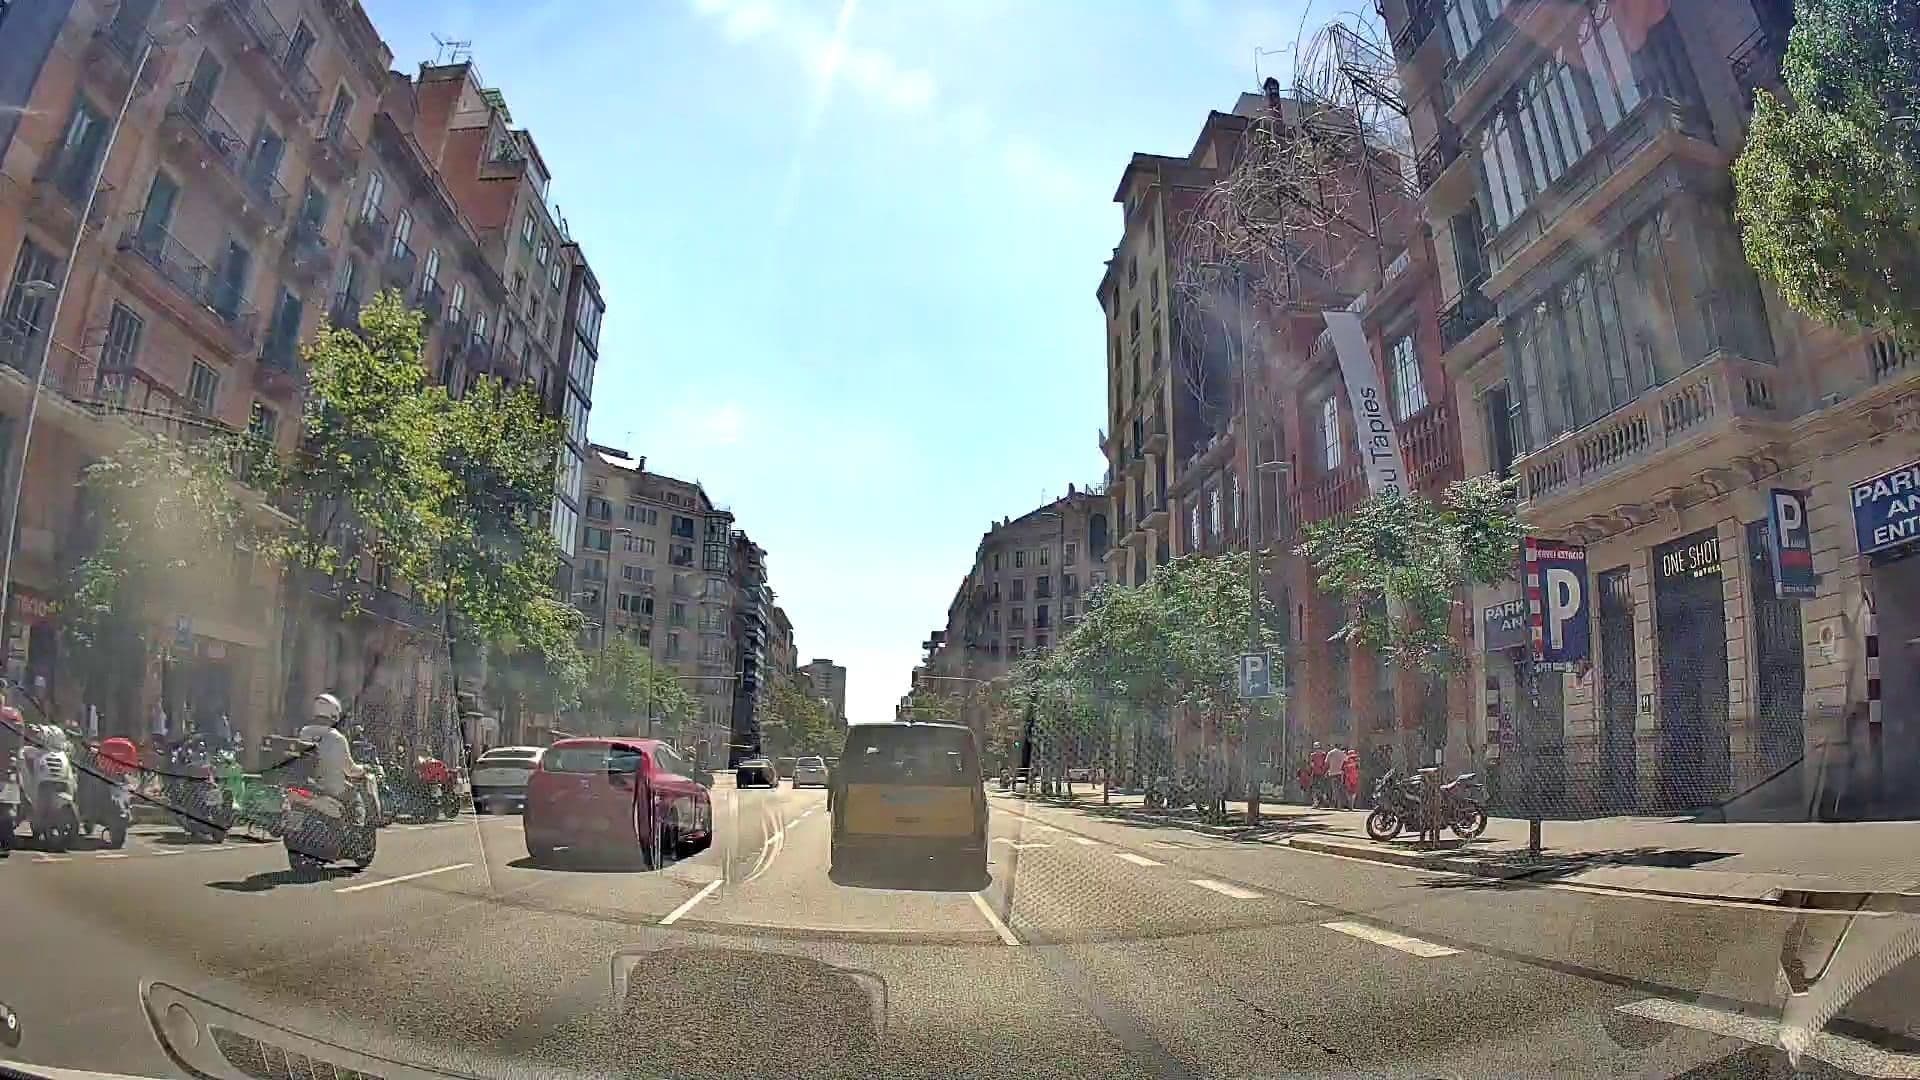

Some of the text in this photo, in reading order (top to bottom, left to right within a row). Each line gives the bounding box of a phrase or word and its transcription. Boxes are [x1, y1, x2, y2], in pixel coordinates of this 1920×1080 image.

[1776, 494, 1801, 548] P
[1874, 516, 1920, 545] ENT
[1663, 538, 1718, 577] ONE SHOT
[1547, 568, 1580, 649] P
[1246, 656, 1263, 681] P
